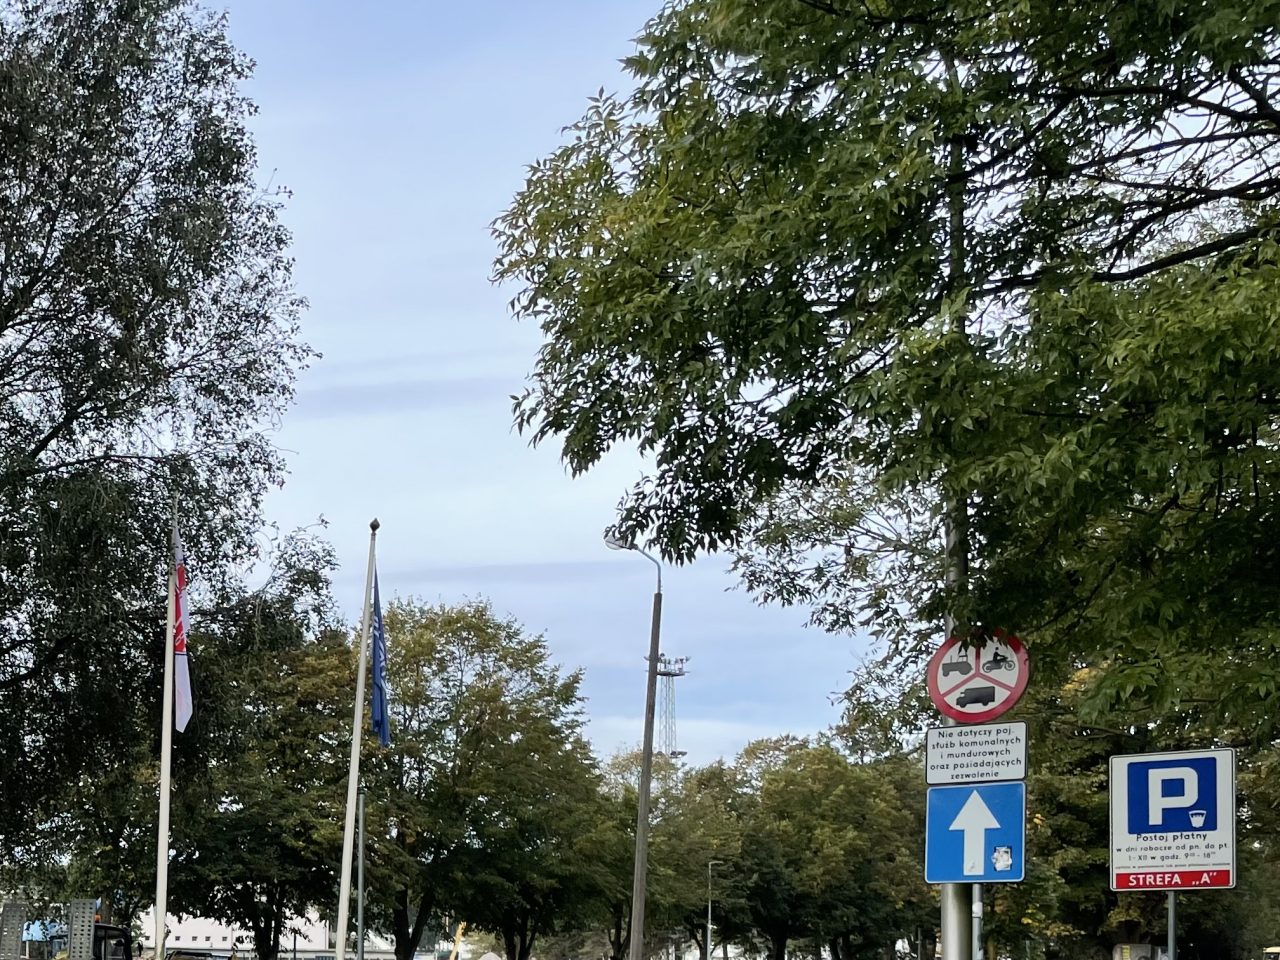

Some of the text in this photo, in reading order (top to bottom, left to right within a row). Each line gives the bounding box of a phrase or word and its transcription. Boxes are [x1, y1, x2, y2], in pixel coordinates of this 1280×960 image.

[938, 727, 1014, 738] Nie dotyczy poj.
[931, 736, 1021, 749] służb komunalnych
[947, 748, 1010, 758] mundurowych
[953, 758, 1022, 770] posiadających
[951, 771, 999, 780] zezwolenie
[1148, 766, 1198, 826] P
[1136, 832, 1208, 842] Postoj płatny
[1128, 873, 1181, 886] STREFA
